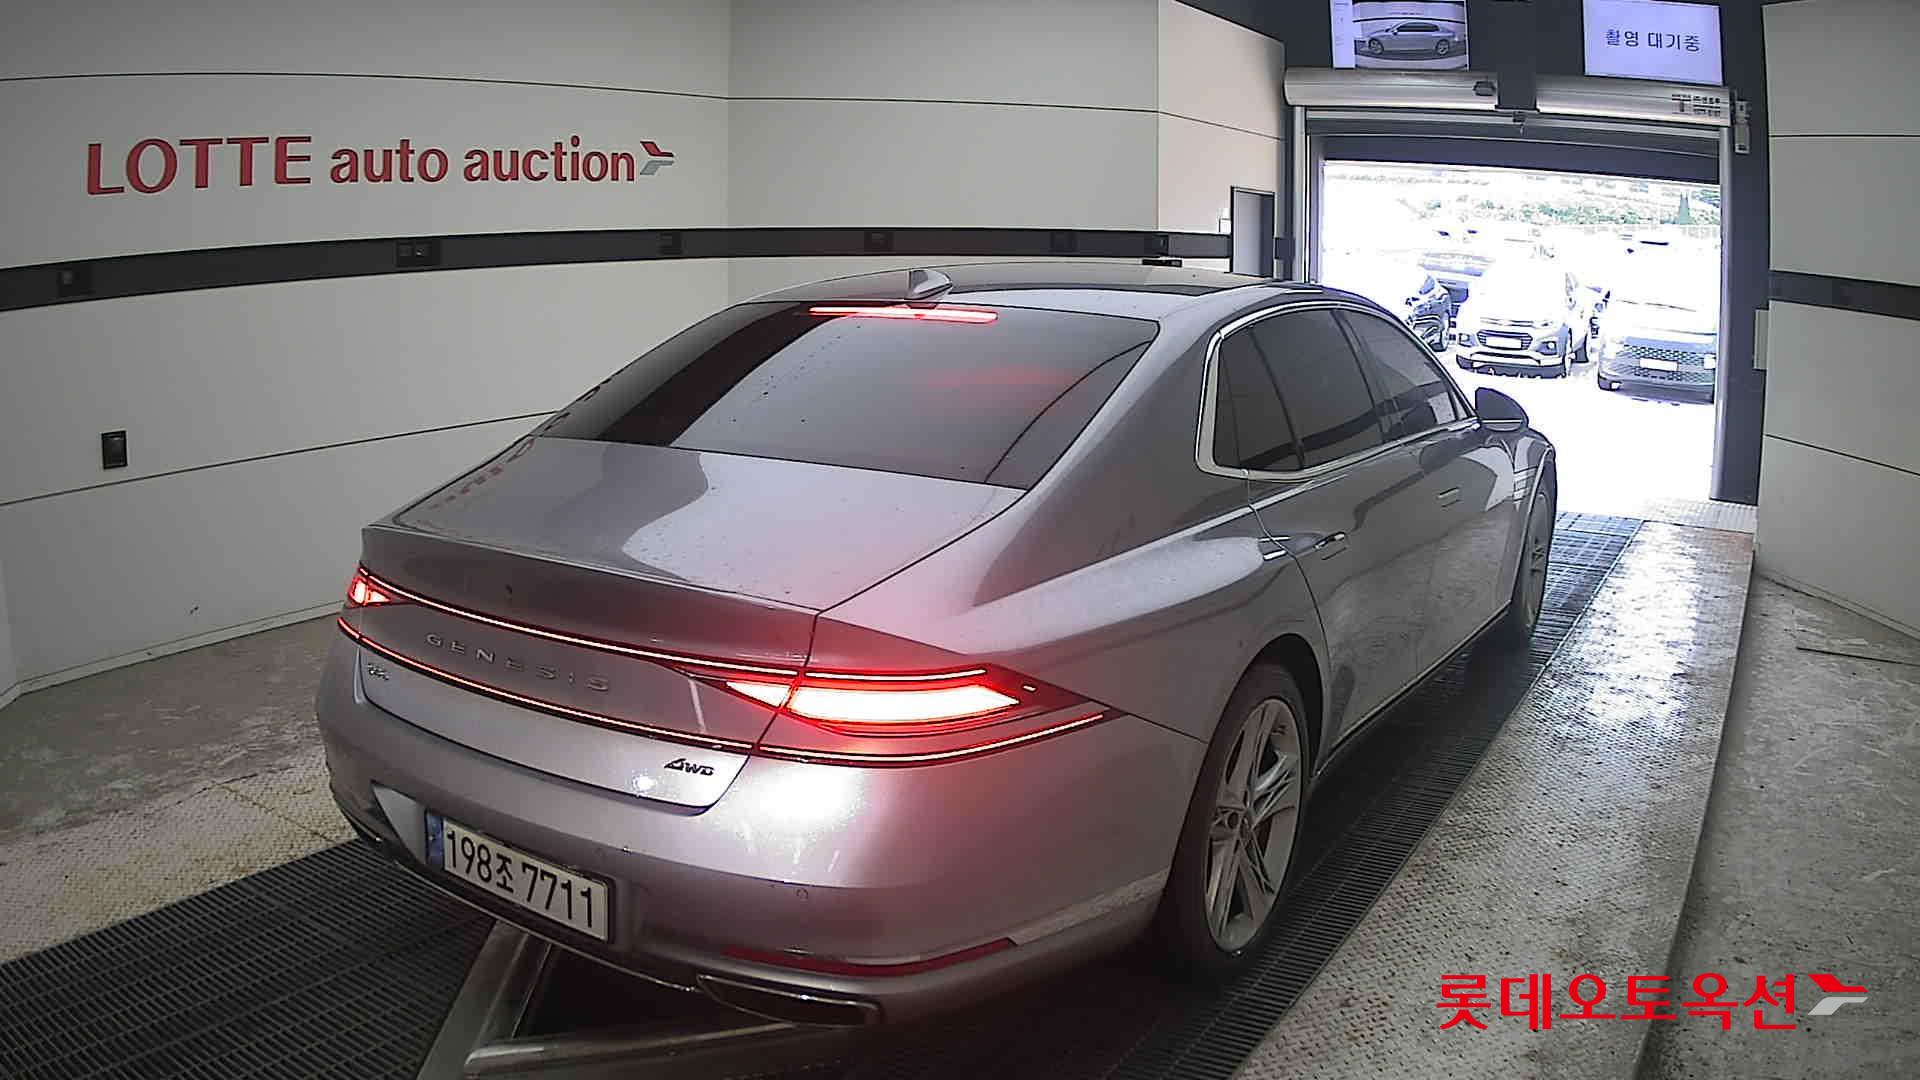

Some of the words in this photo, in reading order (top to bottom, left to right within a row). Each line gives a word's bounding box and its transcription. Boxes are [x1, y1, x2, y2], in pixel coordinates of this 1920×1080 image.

[1647, 31, 1701, 52] 대기중
[86, 135, 312, 195] LOTTE
[329, 138, 449, 184] auto
[463, 135, 636, 183] auction
[425, 632, 610, 693] GENESIS
[446, 830, 514, 895] 198조
[521, 861, 593, 929] 7711
